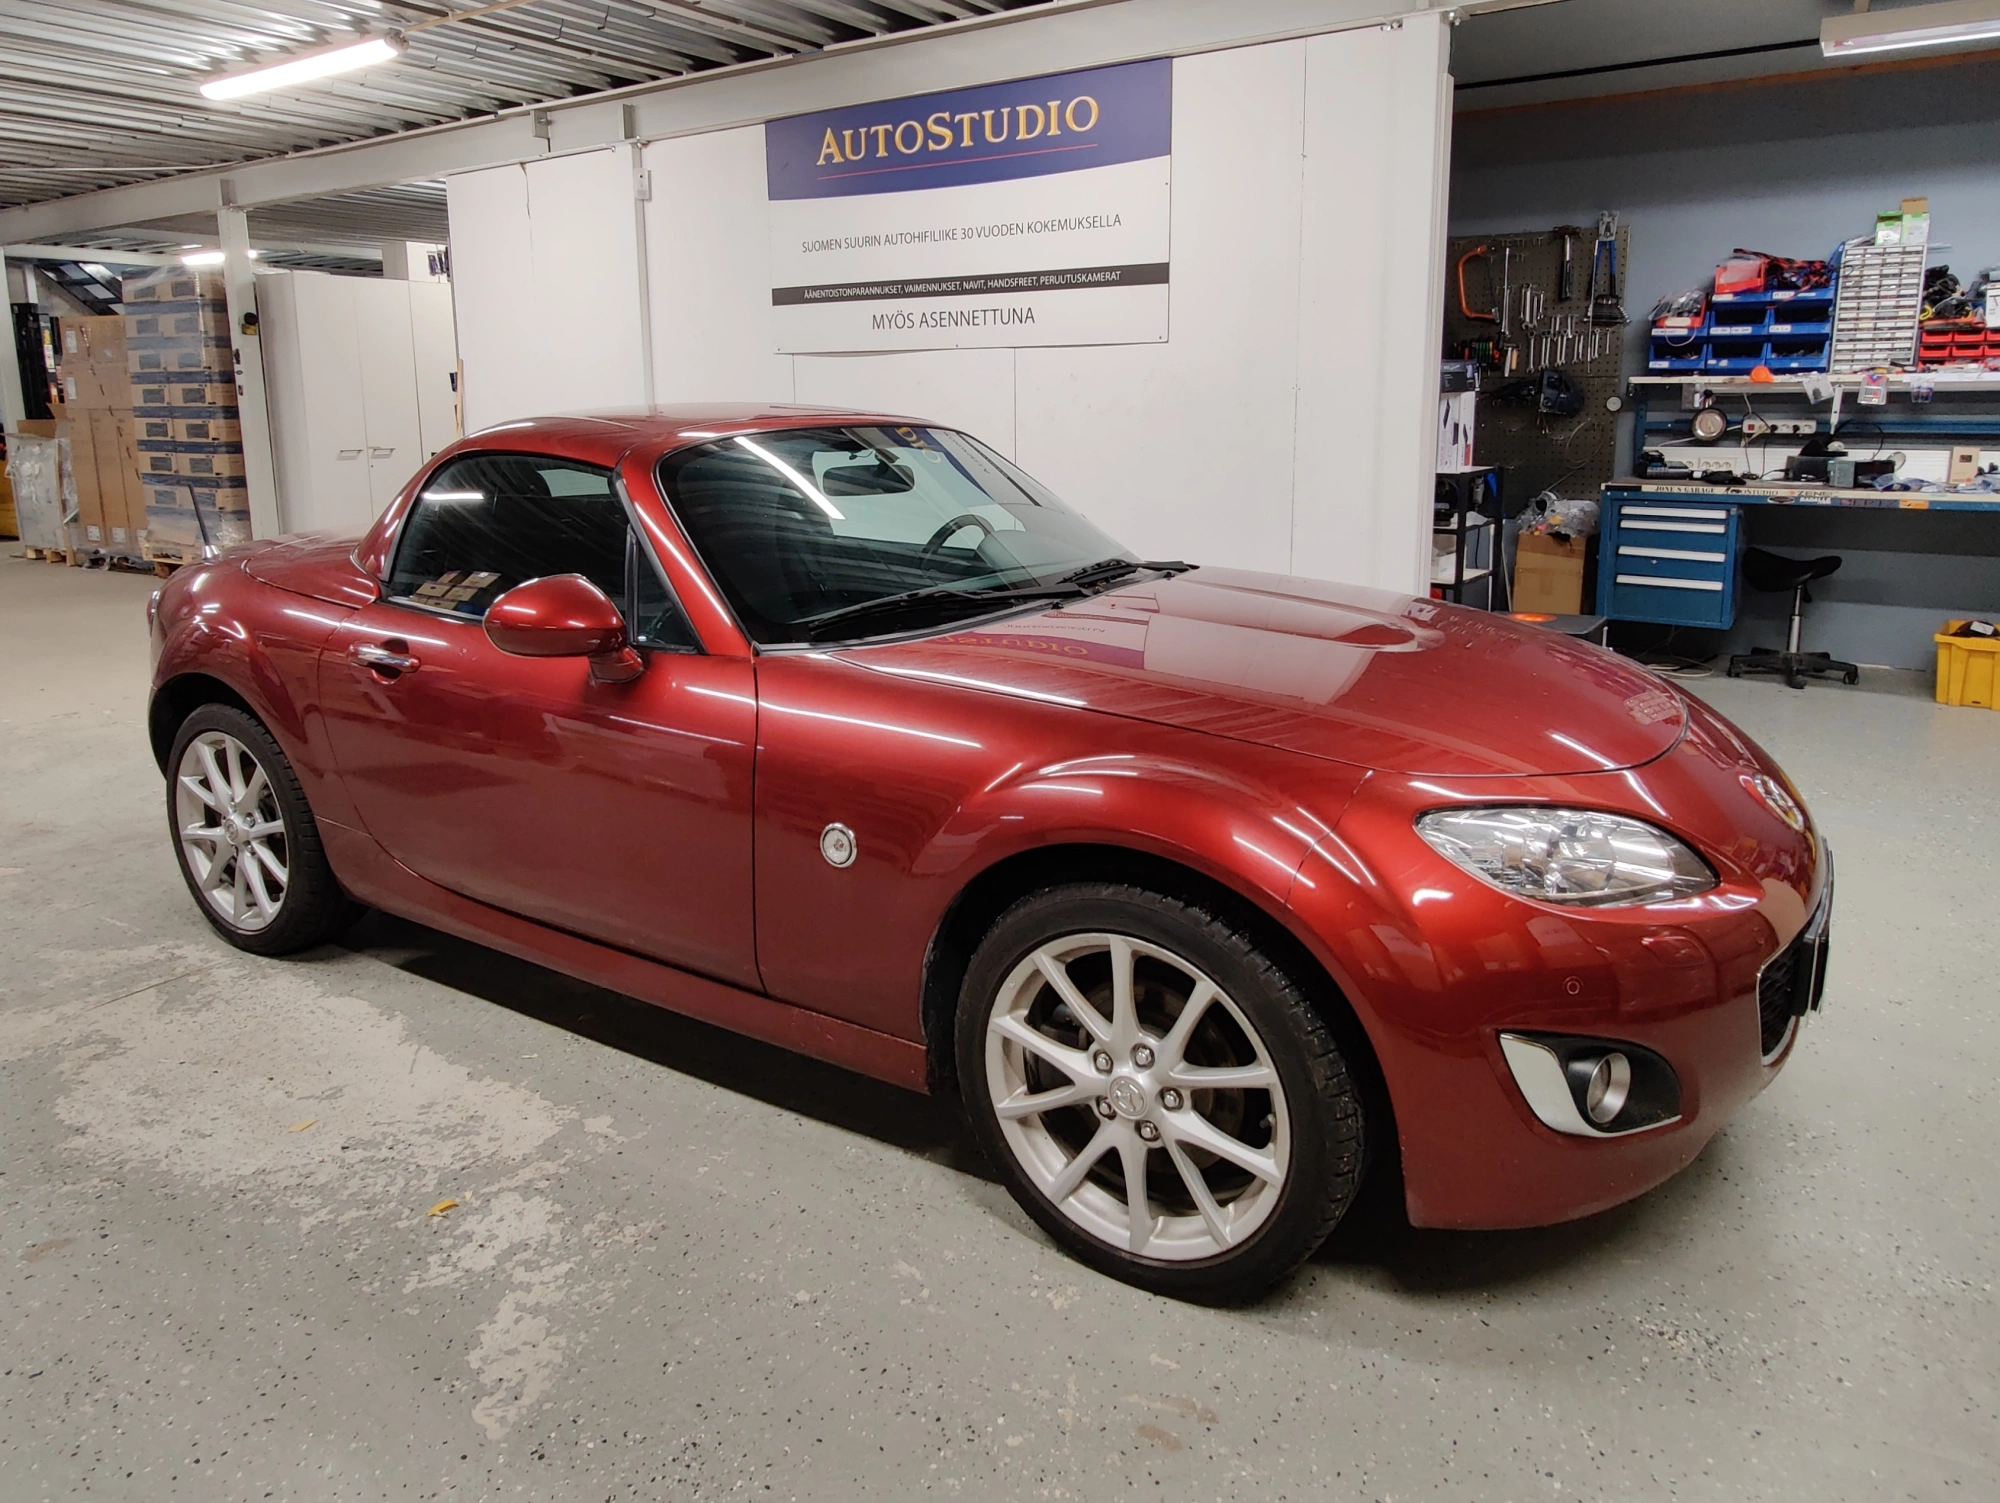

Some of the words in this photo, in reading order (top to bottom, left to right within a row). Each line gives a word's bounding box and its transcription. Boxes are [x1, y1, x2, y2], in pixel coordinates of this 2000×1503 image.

[816, 95, 1100, 166] AUTOSTUDIO
[802, 238, 842, 253] SUOMEN
[844, 234, 881, 250] SUURIN
[883, 228, 958, 246] AUTOHIFILIIKE
[960, 227, 974, 240] 30
[975, 222, 1024, 238] VUODEN
[1027, 213, 1122, 234] KOKEMUKSELLA
[903, 281, 961, 294] VAIMENNUKSET,
[962, 279, 986, 291] NAVIT,
[987, 276, 1039, 289] HANDSFREET,
[1040, 270, 1122, 285] PERUUTUSKAMERAT
[871, 310, 915, 331] MYÖS
[919, 306, 1036, 329] ASENNETTUNA
